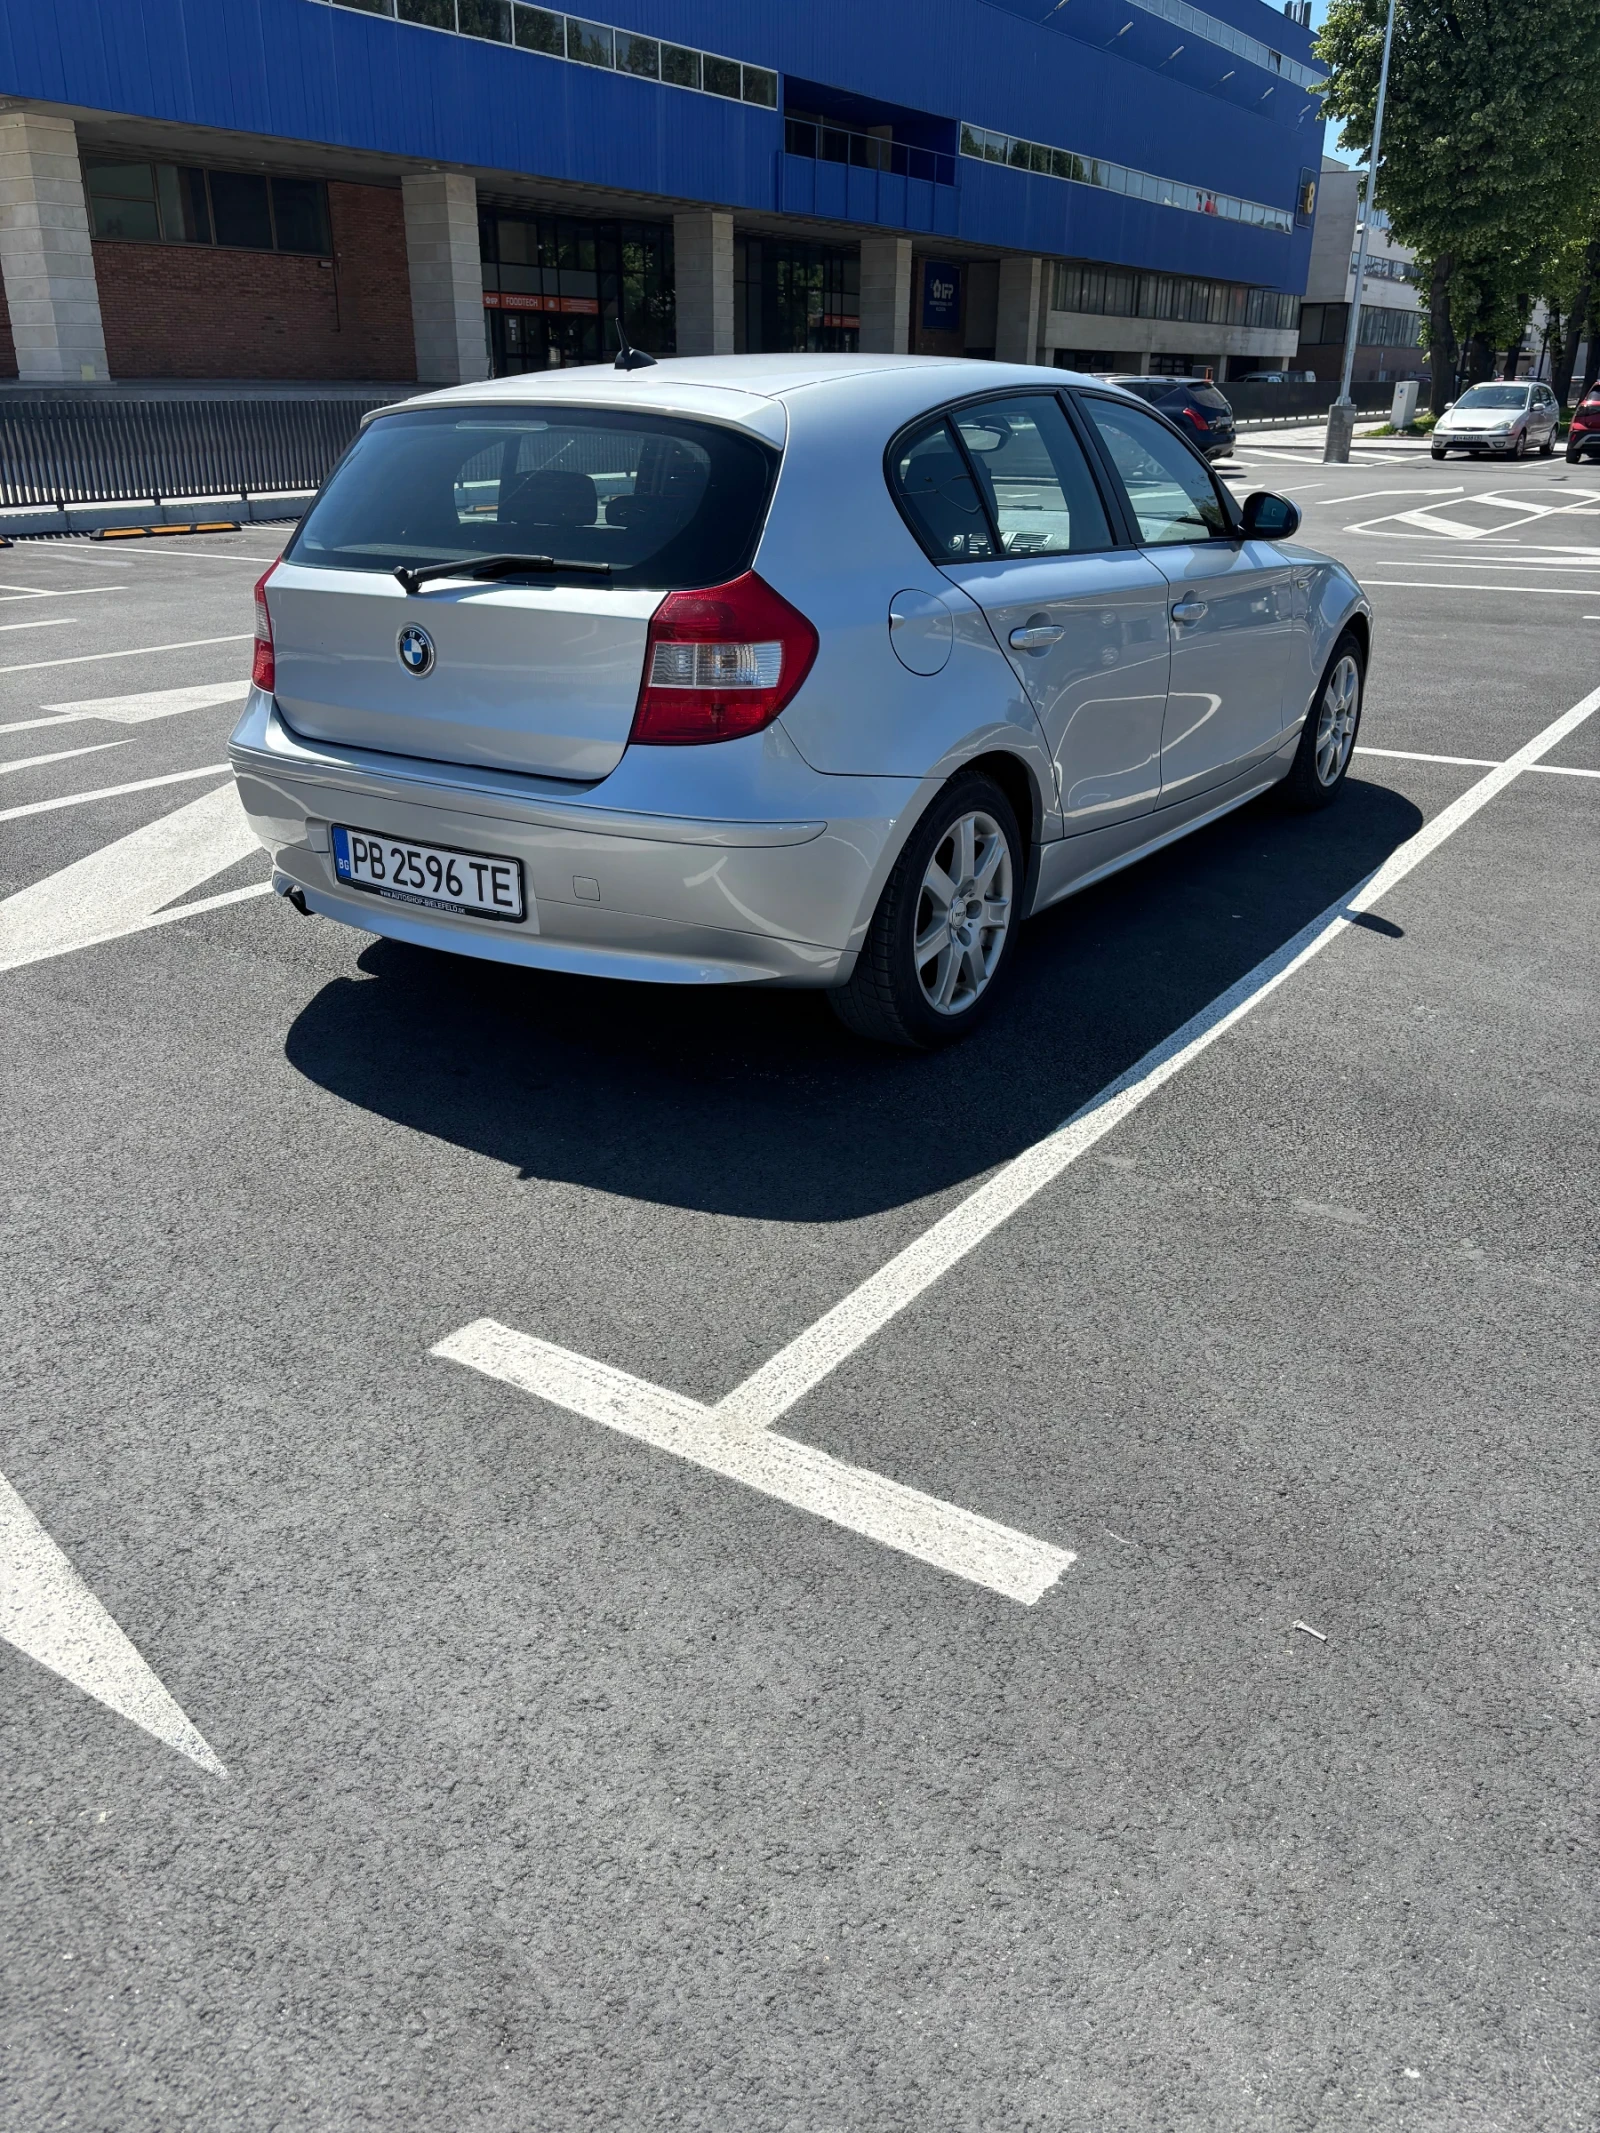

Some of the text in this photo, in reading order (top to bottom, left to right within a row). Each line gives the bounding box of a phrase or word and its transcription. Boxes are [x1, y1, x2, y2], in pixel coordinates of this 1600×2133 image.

[1306, 181, 1316, 214] 8
[506, 296, 538, 307] FOODTECH
[338, 858, 350, 871] BG
[351, 836, 513, 907] PB 2596 TE
